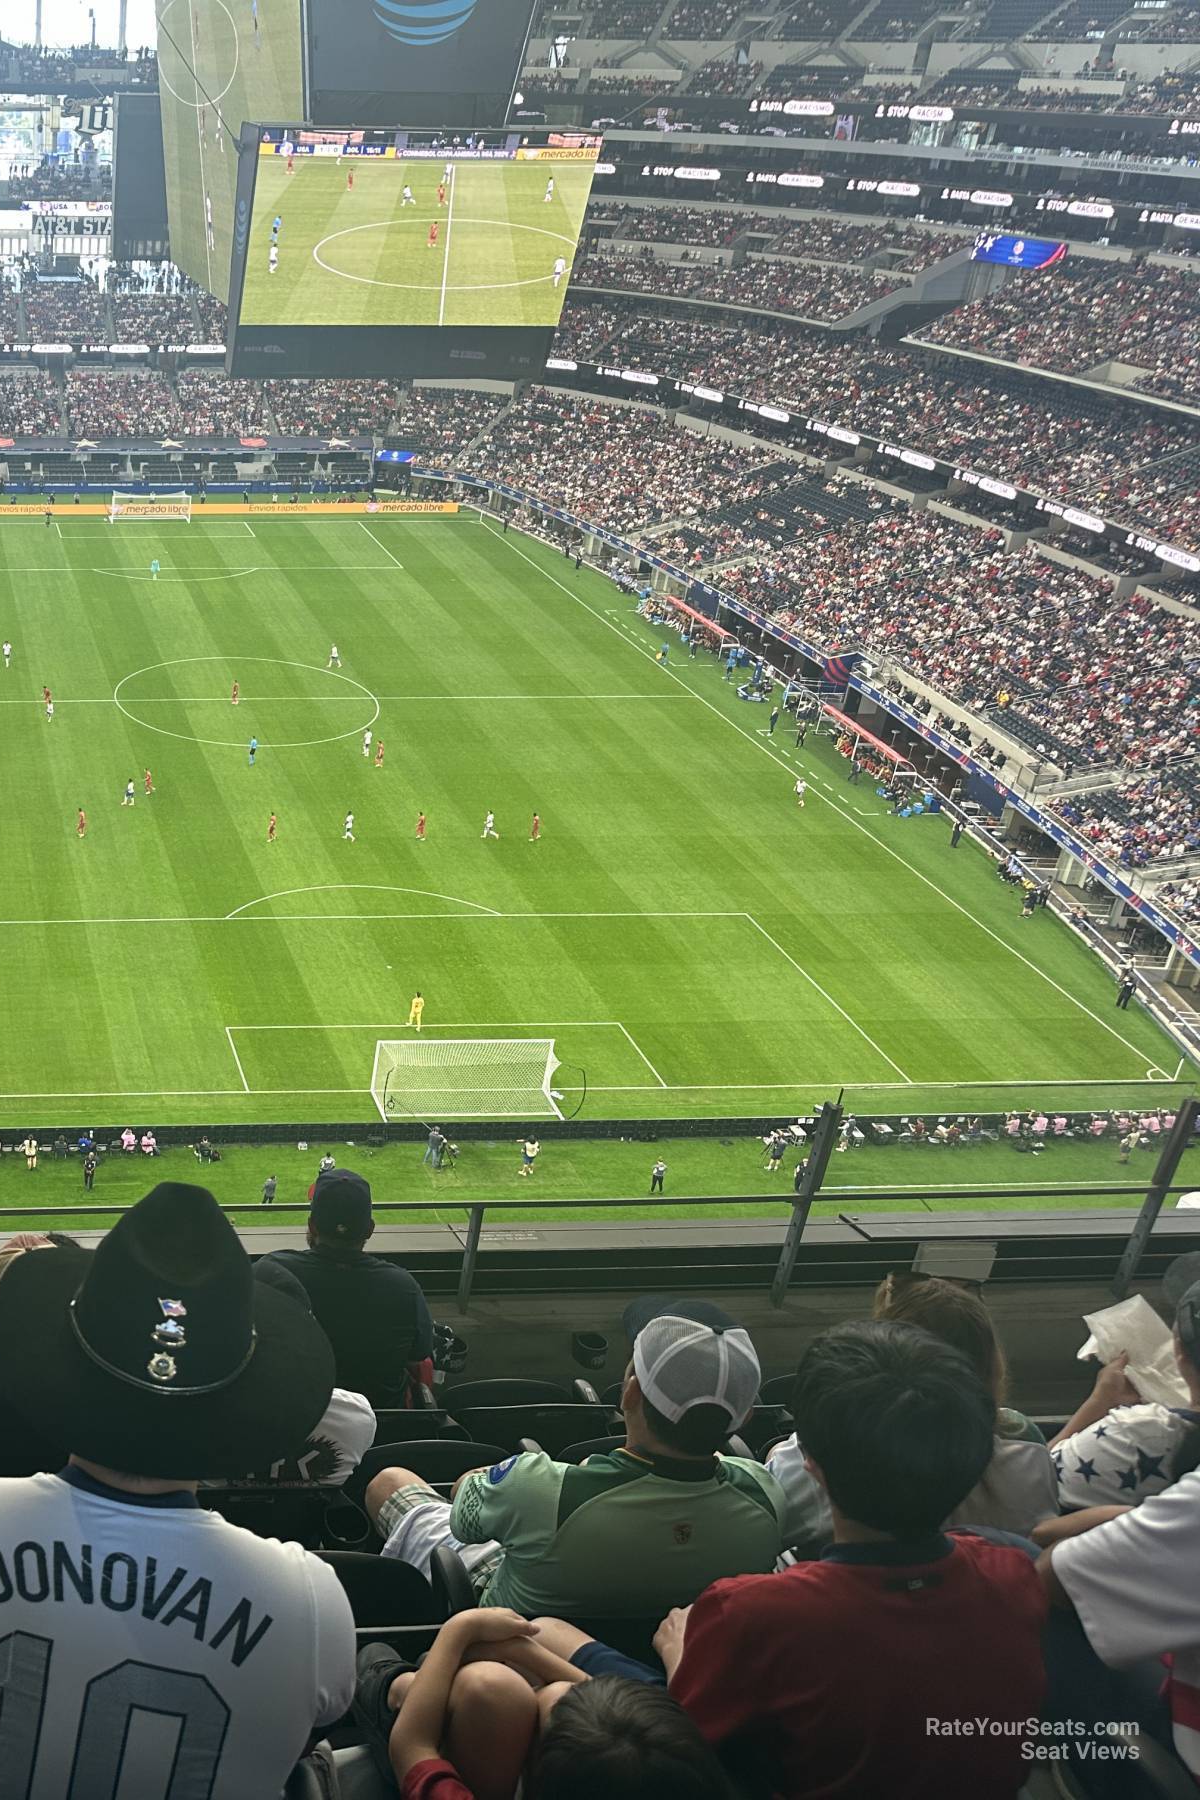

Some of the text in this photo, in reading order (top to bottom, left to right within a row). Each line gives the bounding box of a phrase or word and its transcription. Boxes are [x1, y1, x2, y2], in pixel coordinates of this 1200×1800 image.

[760, 101, 782, 112] BASTA
[887, 106, 943, 118] STOP RACISM
[541, 150, 583, 158] mercado
[653, 167, 674, 176] STOP
[857, 180, 878, 191] STOP
[1047, 200, 1104, 215] STOP RACISM
[1150, 212, 1174, 224] BASTA
[33, 216, 79, 234] AT&T
[13, 344, 31, 352] STOP
[383, 503, 444, 512] mercado libre
[1135, 537, 1191, 565] STOP RACISM
